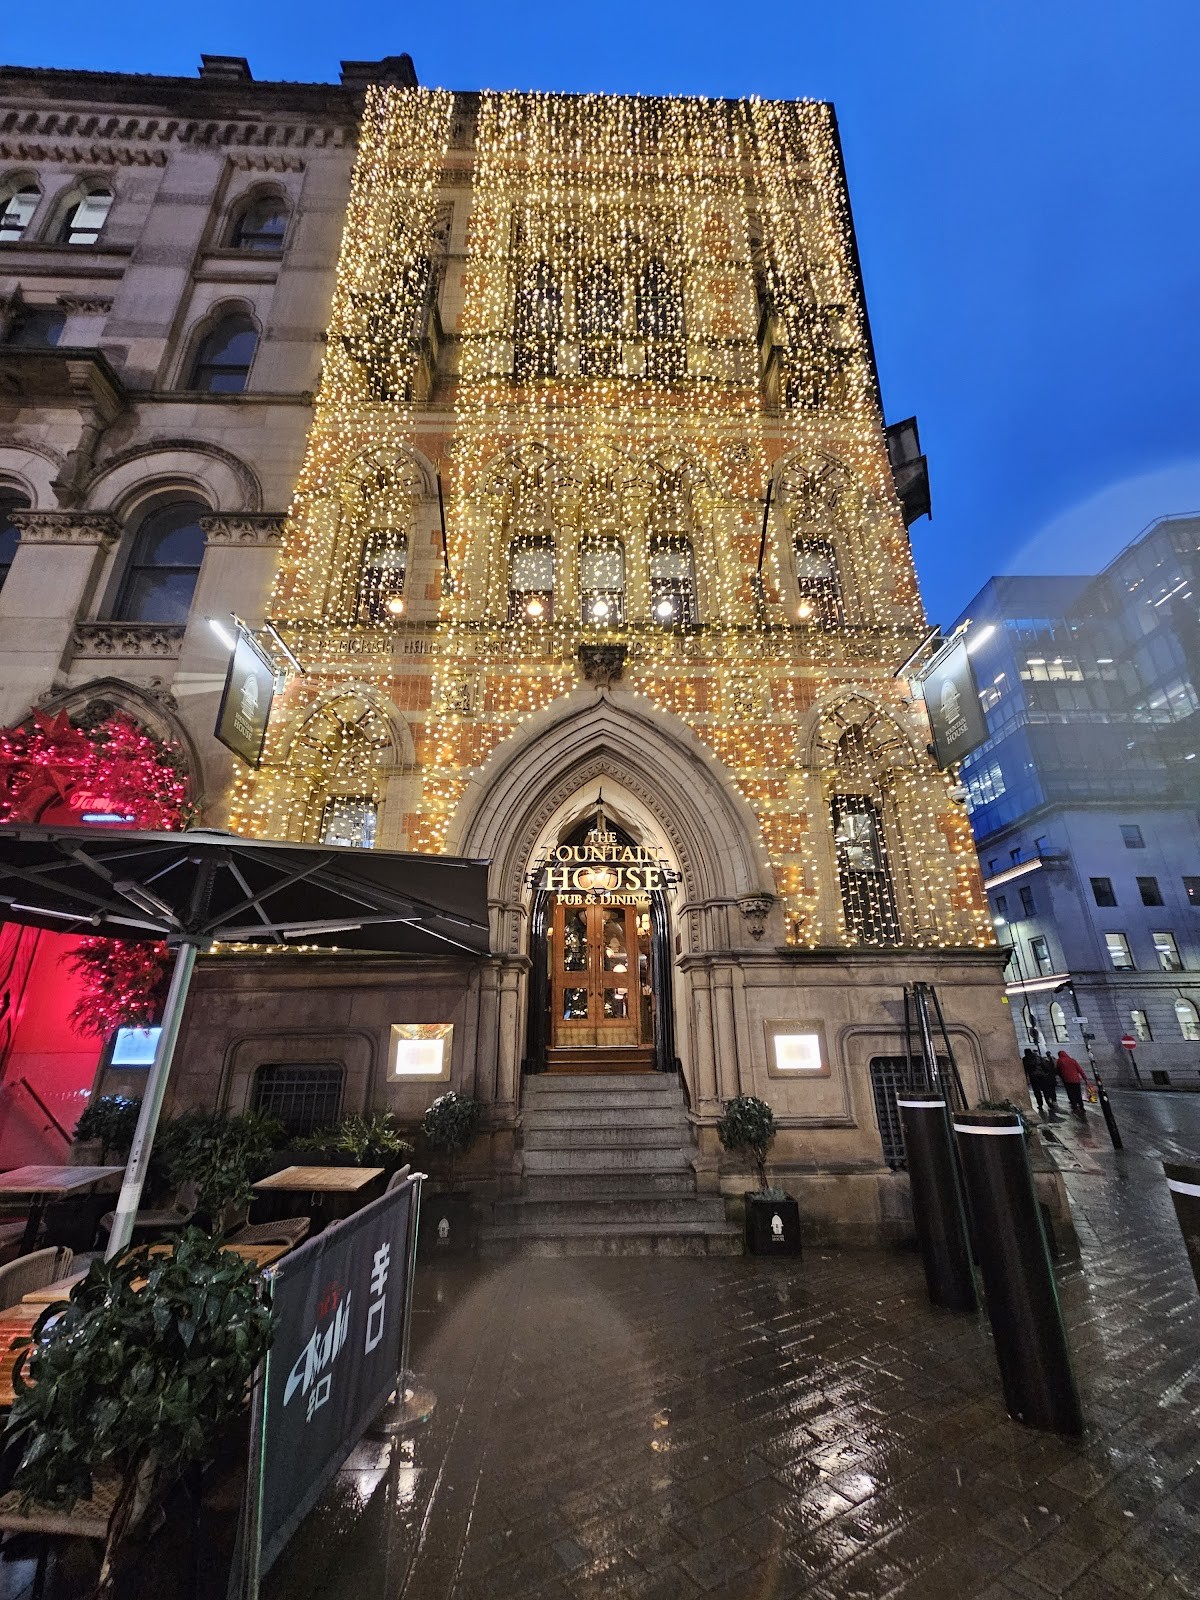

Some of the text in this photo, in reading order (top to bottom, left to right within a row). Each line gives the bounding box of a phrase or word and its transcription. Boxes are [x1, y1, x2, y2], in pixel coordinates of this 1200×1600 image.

[234, 718, 252, 741] HOUSE
[945, 718, 966, 736] FOUNTAIN
[947, 723, 968, 743] HOUSE
[588, 831, 617, 843] THE
[545, 845, 660, 862] FOUNTAIN
[544, 867, 662, 891] HOUSE
[556, 895, 652, 905] PUB & DINING
[283, 1289, 351, 1407] Asahi
